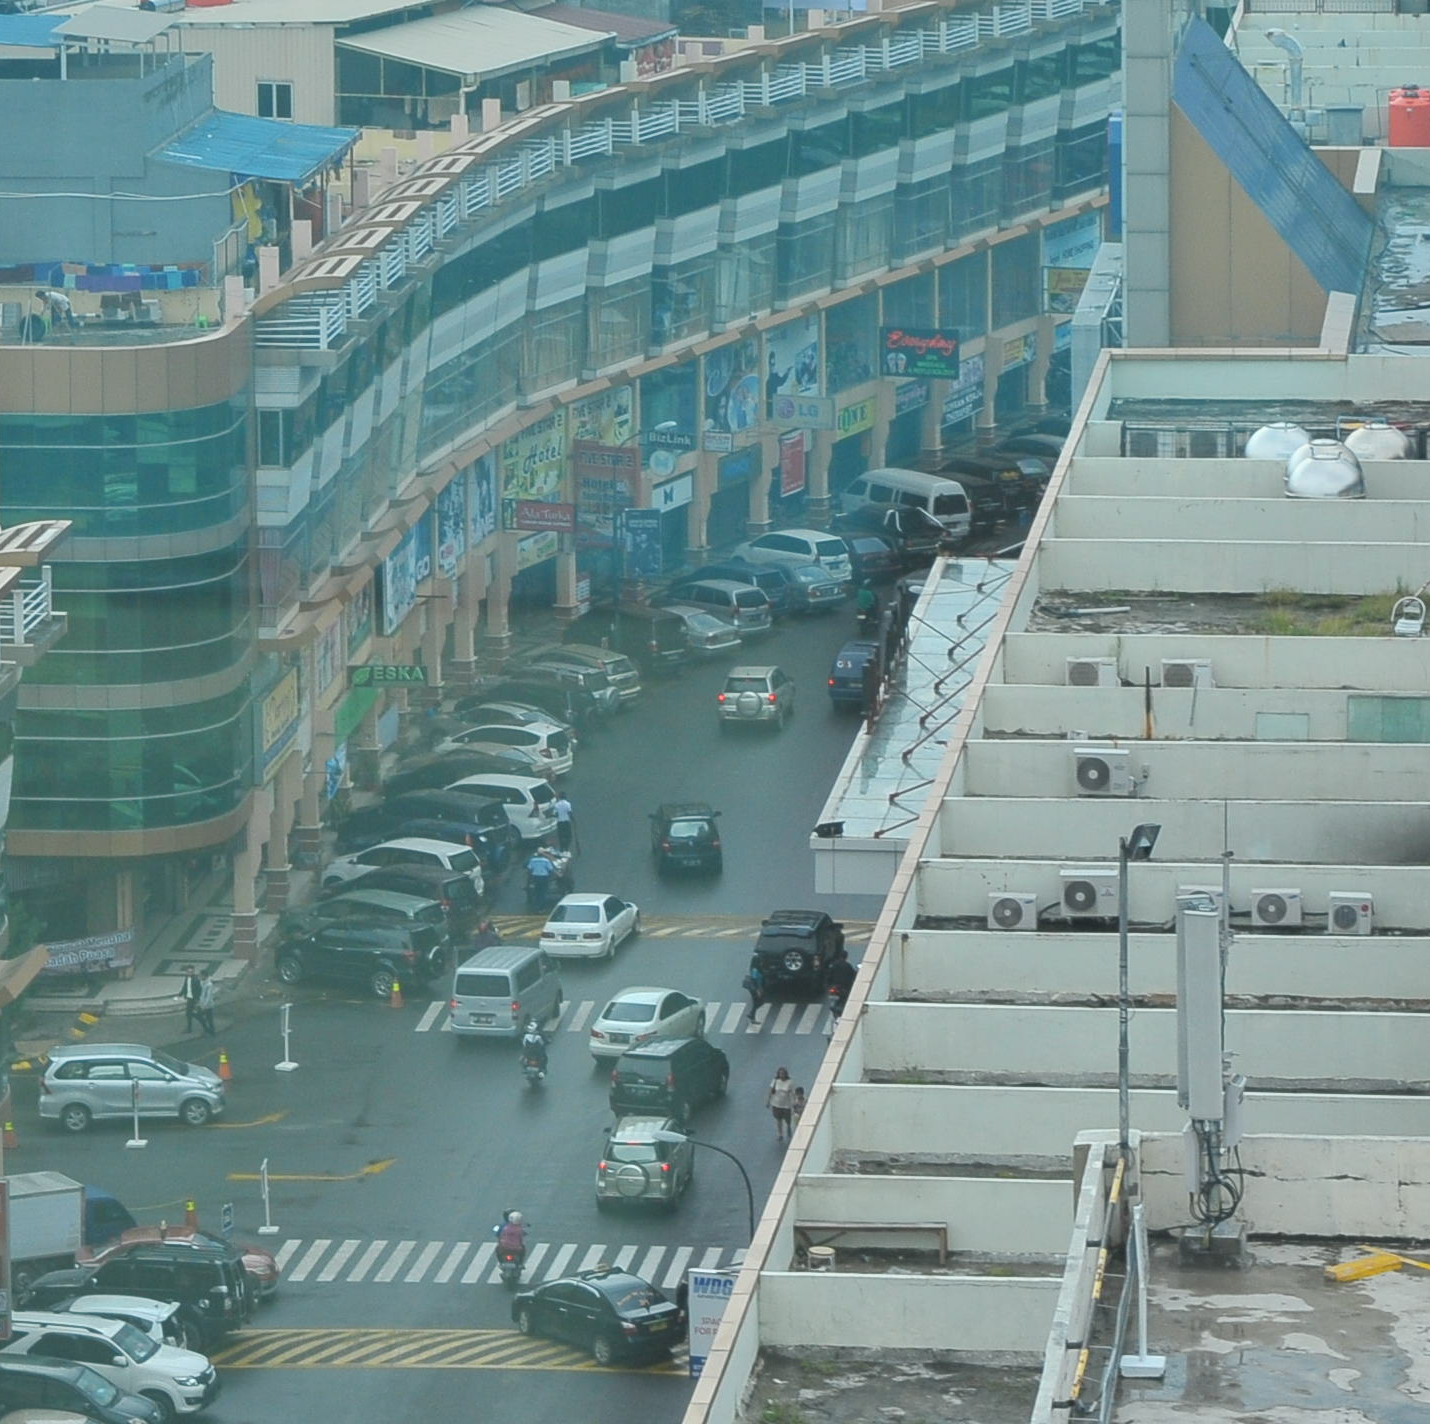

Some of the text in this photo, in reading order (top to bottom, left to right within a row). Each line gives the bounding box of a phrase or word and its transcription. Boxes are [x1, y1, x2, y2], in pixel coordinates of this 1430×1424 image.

[798, 404, 819, 418] LG
[649, 431, 692, 445] BizLink
[523, 435, 563, 475] Hotel
[374, 666, 424, 681] ESKA
